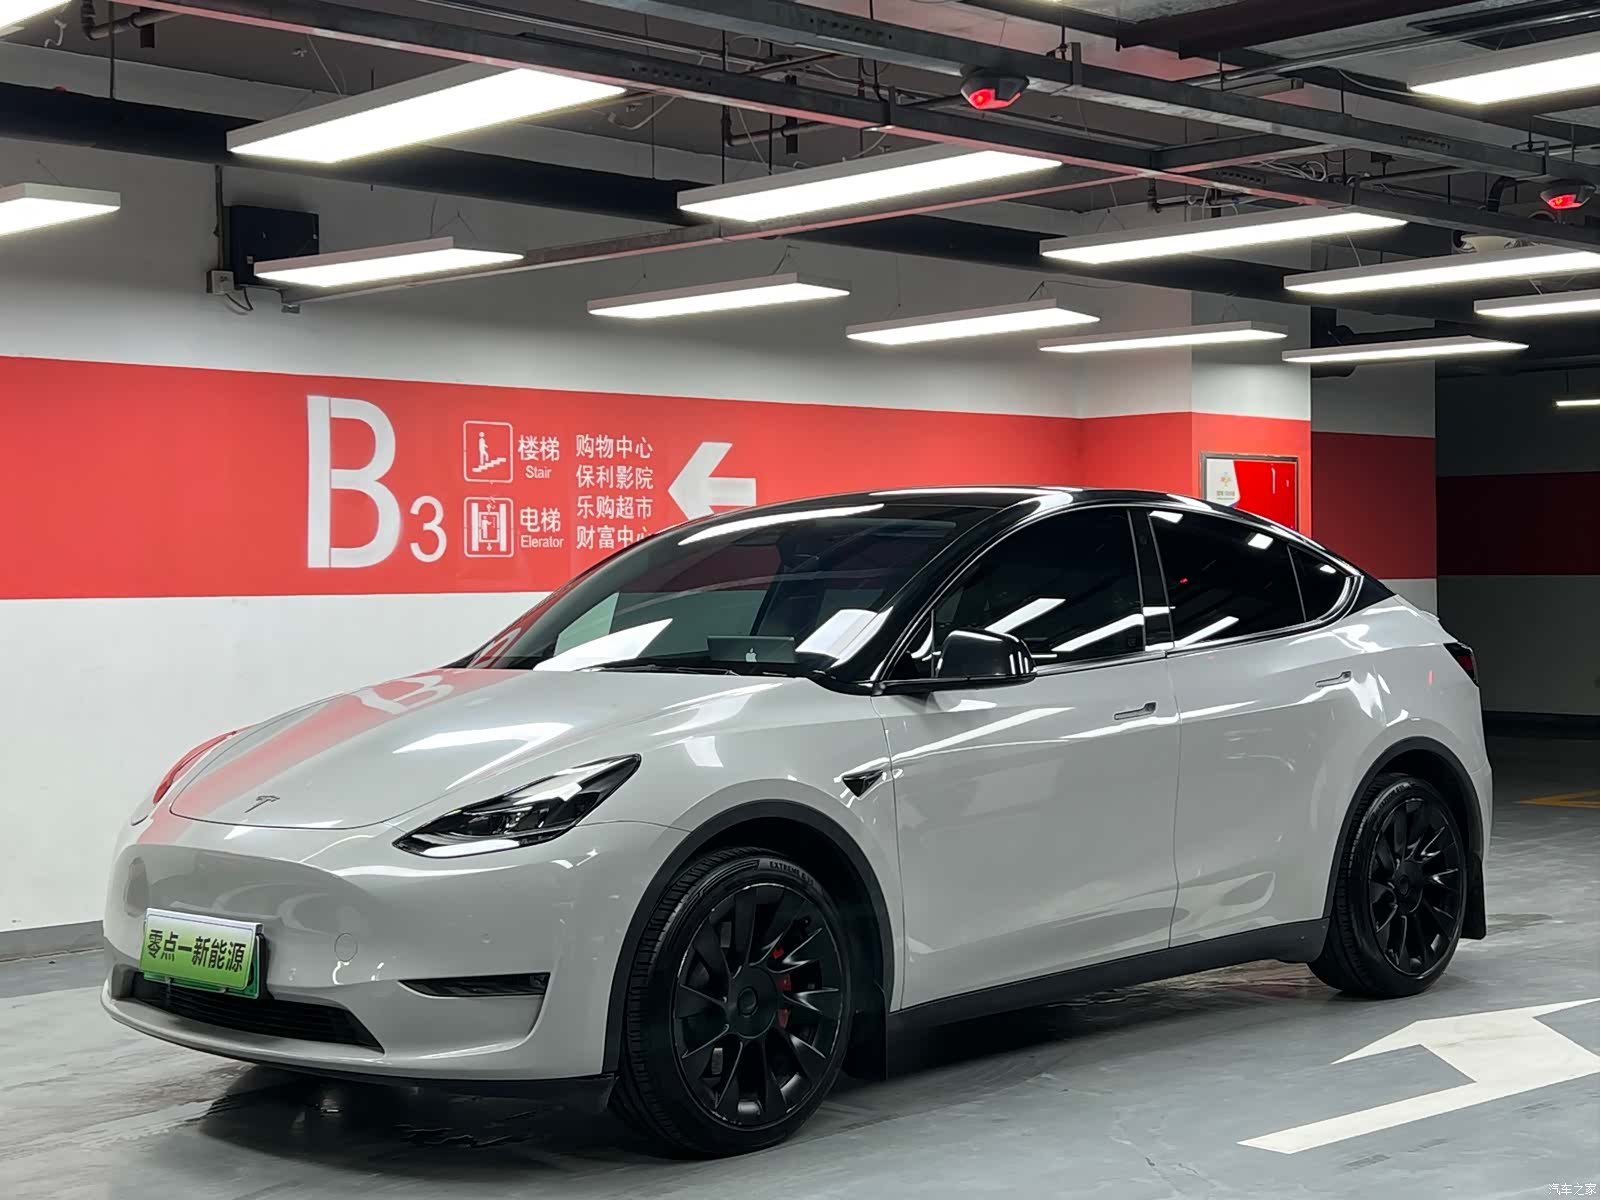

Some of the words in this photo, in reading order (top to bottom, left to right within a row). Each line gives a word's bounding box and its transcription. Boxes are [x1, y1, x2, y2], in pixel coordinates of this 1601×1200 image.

[518, 434, 560, 461] 楼梯
[575, 433, 654, 459] 购物中心
[525, 465, 552, 479] Stair
[575, 464, 654, 490] 保利影院
[519, 506, 561, 533] 电梯
[576, 495, 653, 519] 乐购超市
[146, 928, 247, 973] 零点一新能源
